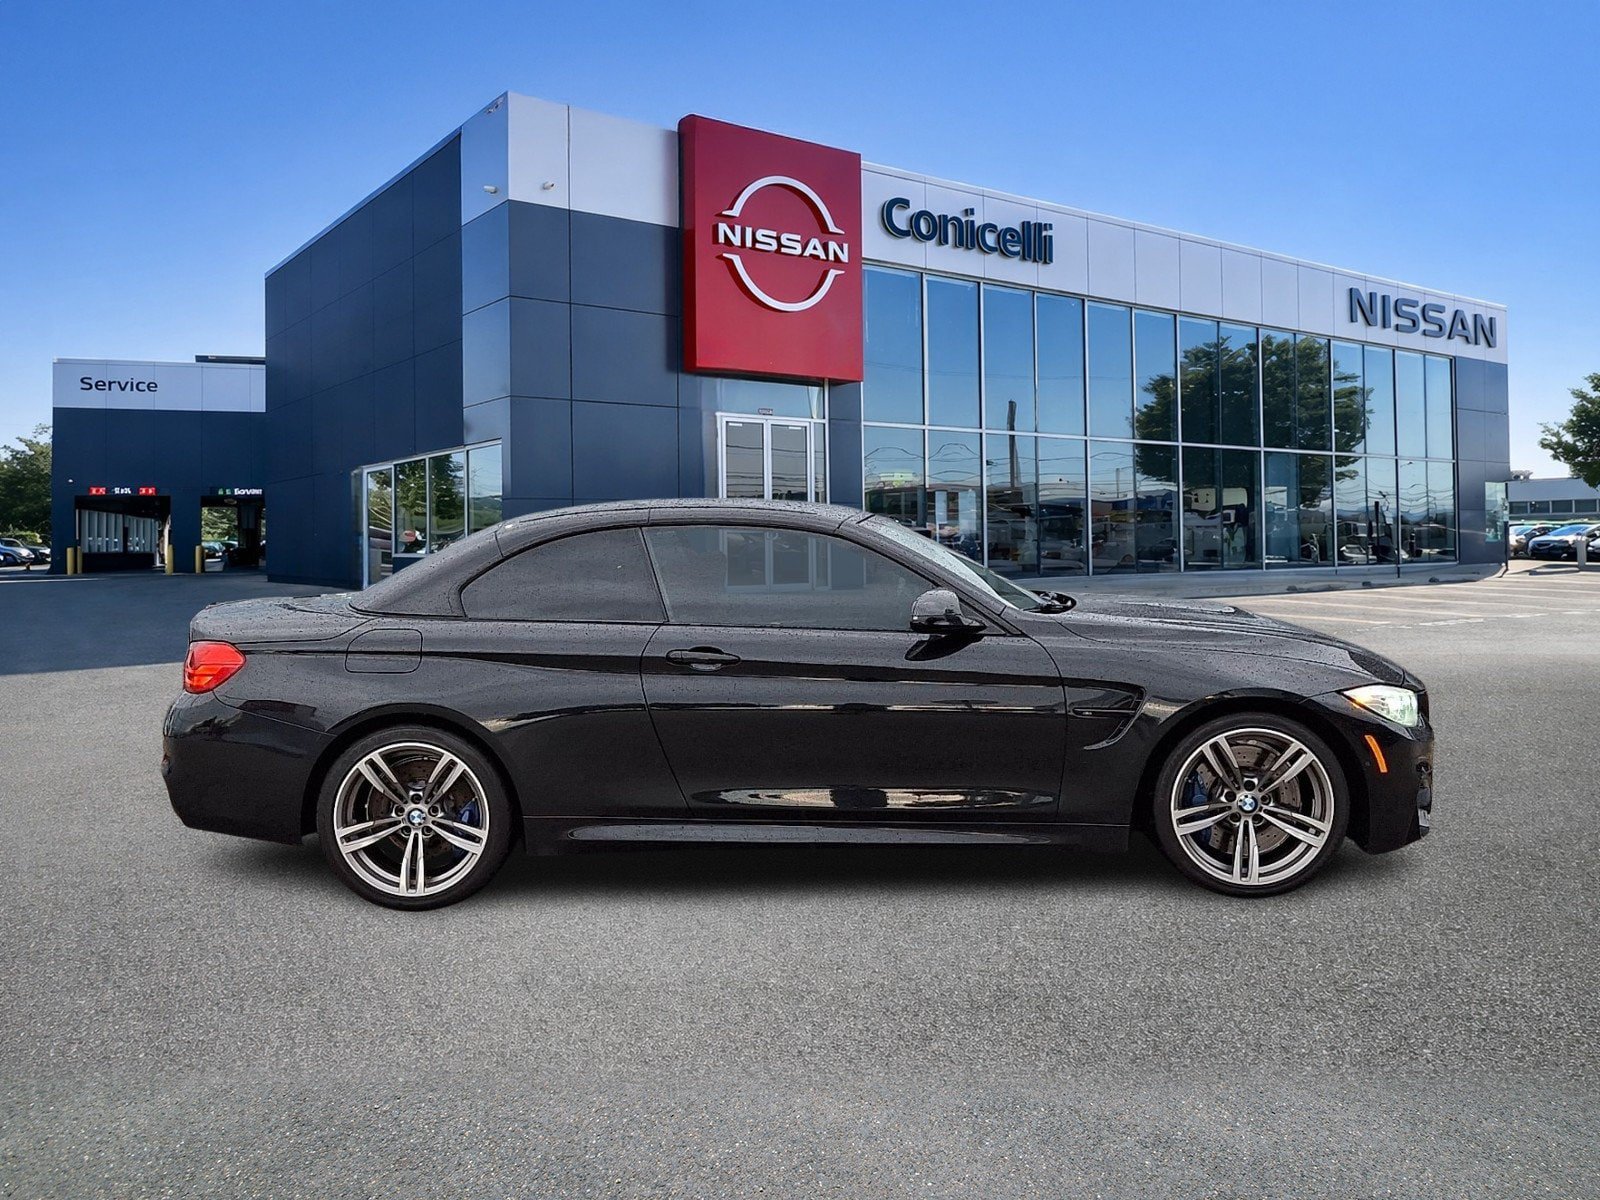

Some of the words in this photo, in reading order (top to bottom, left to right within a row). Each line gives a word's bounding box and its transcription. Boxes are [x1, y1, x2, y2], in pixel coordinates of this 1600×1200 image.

[718, 222, 849, 264] NISSAN
[881, 197, 1054, 264] Conicelli
[1349, 287, 1497, 349] NISSAN
[80, 377, 158, 392] Service
